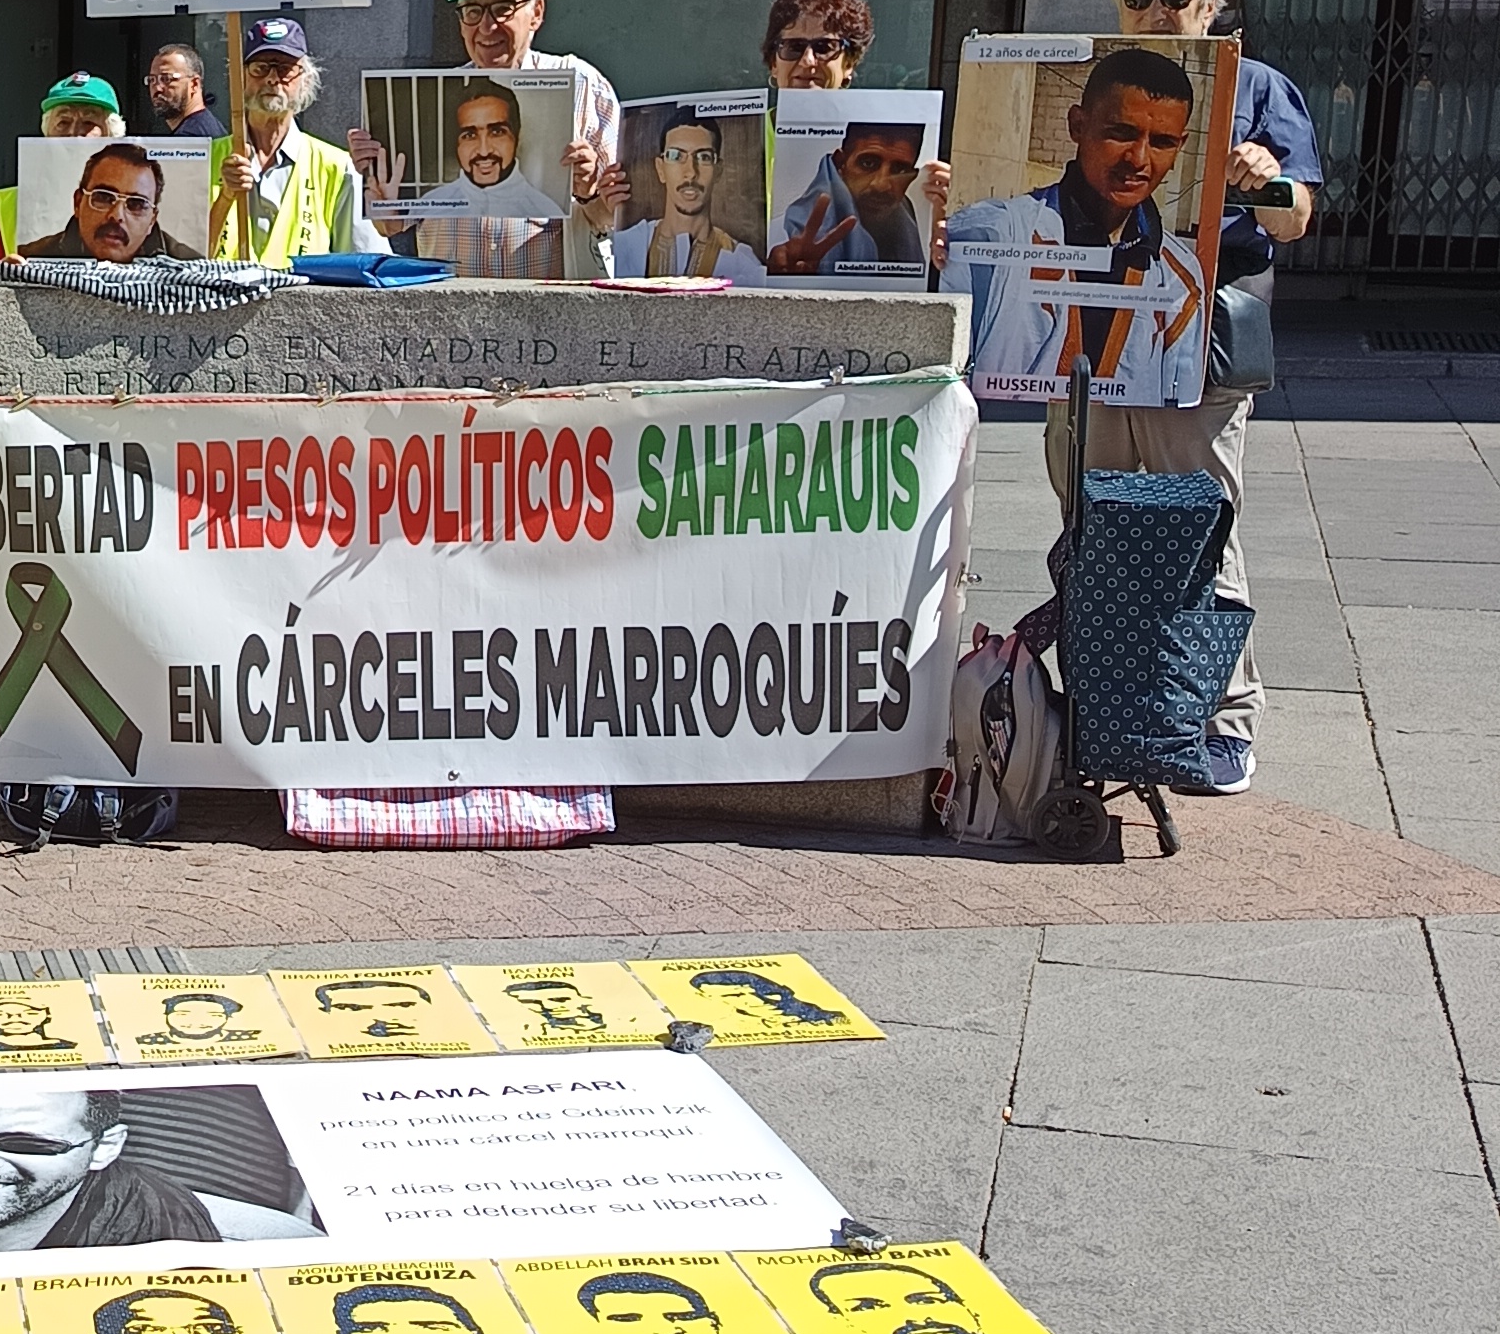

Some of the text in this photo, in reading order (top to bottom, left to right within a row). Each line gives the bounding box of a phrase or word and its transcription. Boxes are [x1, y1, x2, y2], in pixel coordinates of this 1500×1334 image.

[979, 46, 1078, 58] 12 años de cárcel
[539, 80, 569, 89] Perpetua
[698, 102, 764, 114] Cadena perpetua
[808, 128, 844, 137] Perpetua
[176, 150, 206, 159] Perpetua
[963, 246, 1087, 262] Entregado por España
[1032, 289, 1050, 297] antes
[34, 335, 75, 360] SE
[112, 333, 249, 360] FIRMO
[286, 335, 343, 362] EN
[380, 337, 557, 365] MADRID
[599, 341, 648, 368] EL
[695, 342, 910, 375] TRATADO
[986, 377, 1056, 394] HUSSEIN
[175, 435, 356, 550] PRESOS
[369, 404, 614, 546] POLÍTICOS
[636, 414, 920, 540] SAHARAUIS
[168, 589, 912, 746] EN CÁRCELES MARROQUÍES
[362, 1086, 491, 1103] NAAMA
[320, 1117, 398, 1132] preso
[408, 1111, 508, 1129] político
[518, 1108, 552, 1122] de
[362, 1138, 396, 1150] en
[407, 1135, 460, 1148] una
[470, 1129, 556, 1146] cárcel
[344, 1167, 784, 1197] 21 días en huelga de hambre
[385, 1207, 452, 1224] para
[463, 1200, 598, 1220] defender
[609, 1202, 645, 1214] su
[514, 1255, 720, 1274] ABDELLAH BRAH SIDI
[757, 1247, 952, 1267] MOHAMED BANI
[288, 1269, 477, 1286] BOUTENGUIZA
[297, 1263, 379, 1275] MOHAMED
[33, 1272, 248, 1292] BRAHIM ISMAILI
